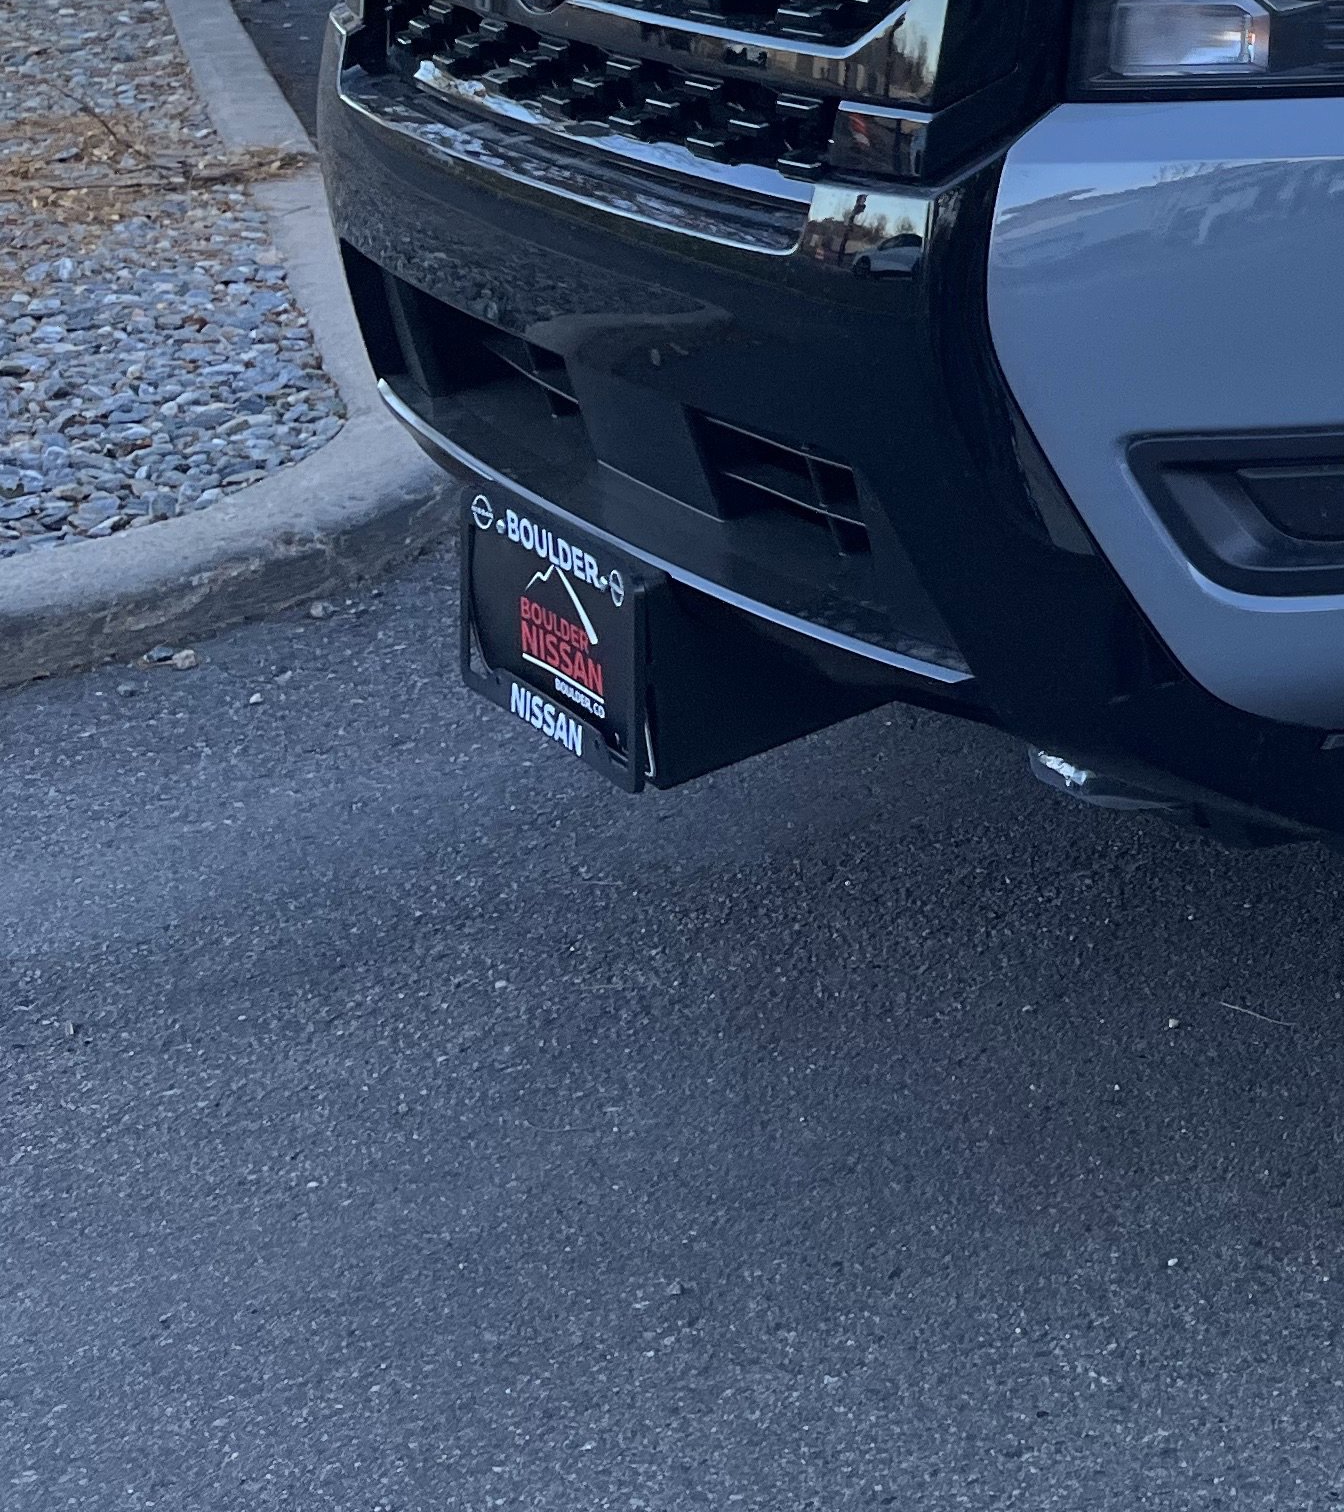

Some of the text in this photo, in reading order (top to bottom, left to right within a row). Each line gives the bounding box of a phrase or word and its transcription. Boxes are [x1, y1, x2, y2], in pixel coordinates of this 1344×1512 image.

[506, 508, 603, 589] BOULDER
[519, 595, 589, 650] BOULDER
[520, 620, 604, 697] NISSAN
[510, 682, 583, 757] NISSAN
